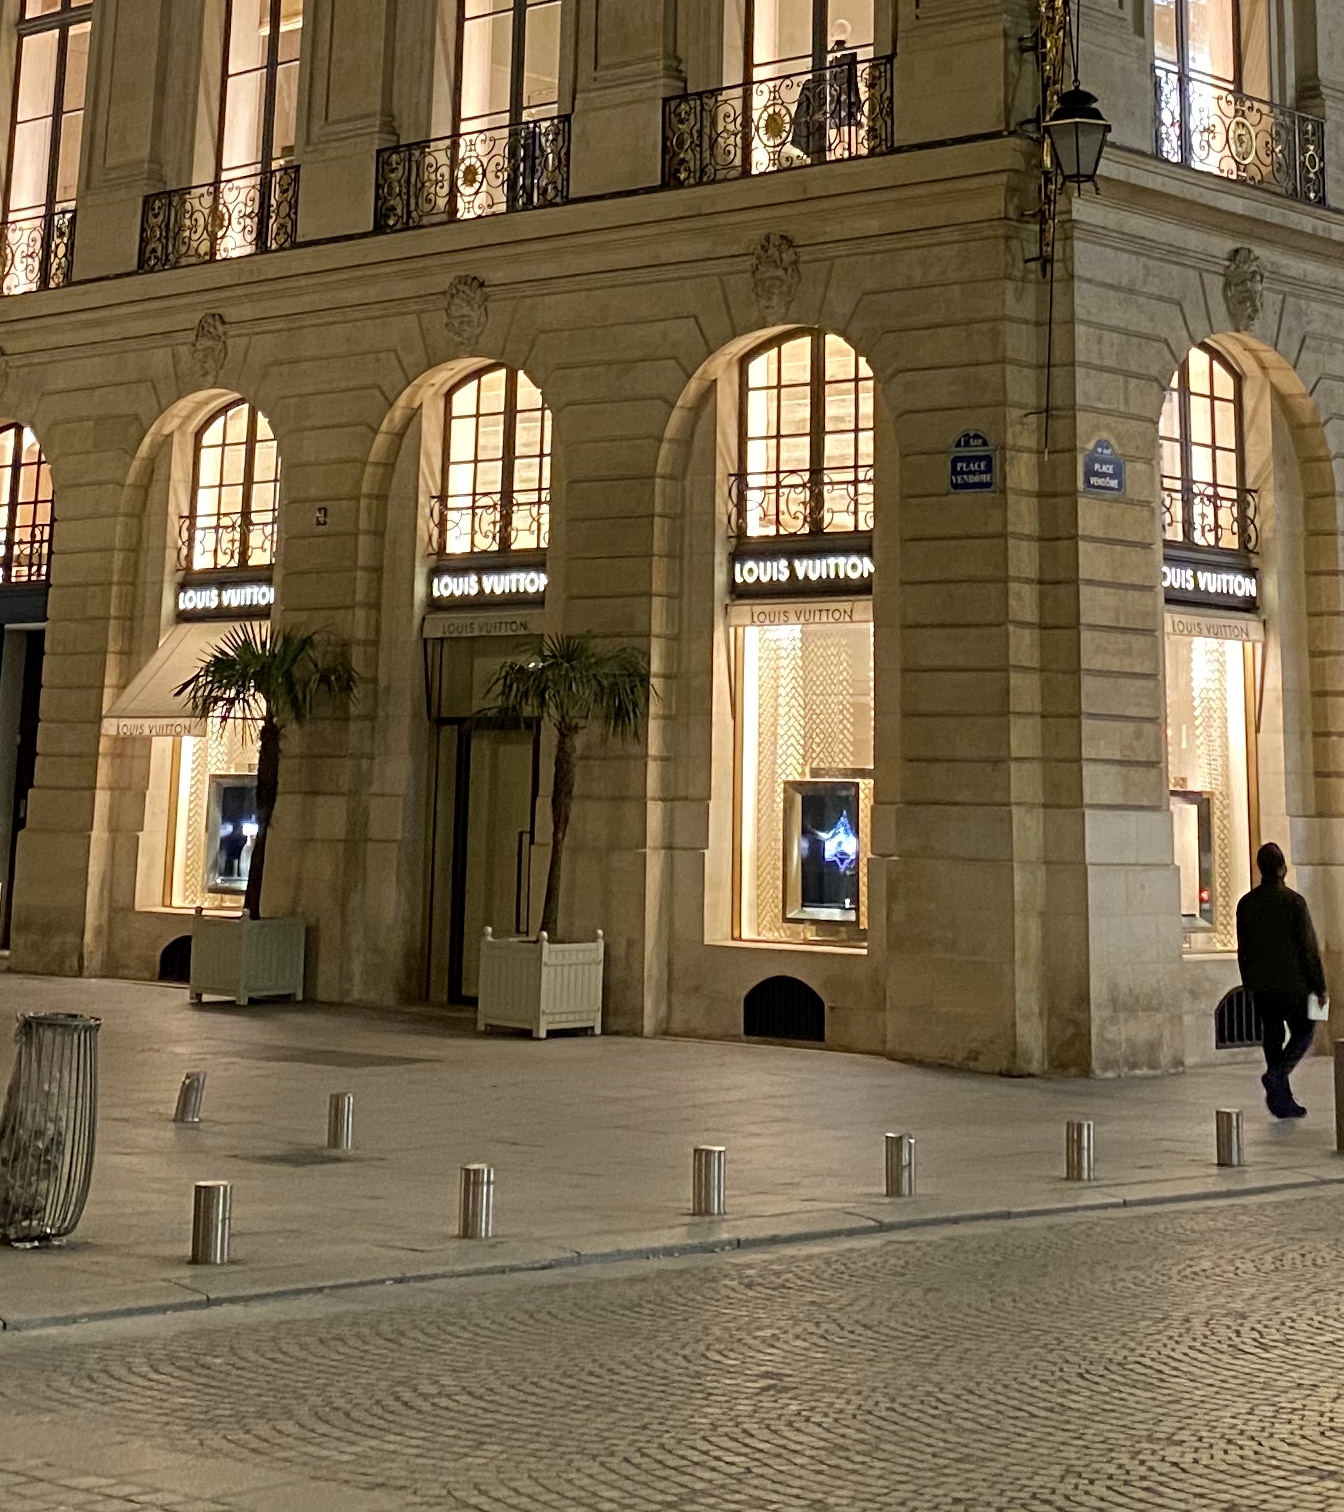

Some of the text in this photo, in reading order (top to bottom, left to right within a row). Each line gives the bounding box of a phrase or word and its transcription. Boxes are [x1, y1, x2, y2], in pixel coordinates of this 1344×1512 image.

[957, 461, 987, 472] PLACE
[734, 558, 790, 583] LOUIS
[432, 574, 479, 598] LOUIS
[1161, 565, 1257, 597] OUIS VUITTON
[178, 587, 219, 610] LOUIS
[751, 607, 854, 624] LOUIS VUITTON
[442, 620, 529, 635] LOUIS VUITTON
[1172, 618, 1250, 638] LOUIS VUITTON
[117, 723, 192, 735] LOUIS VUITTON
